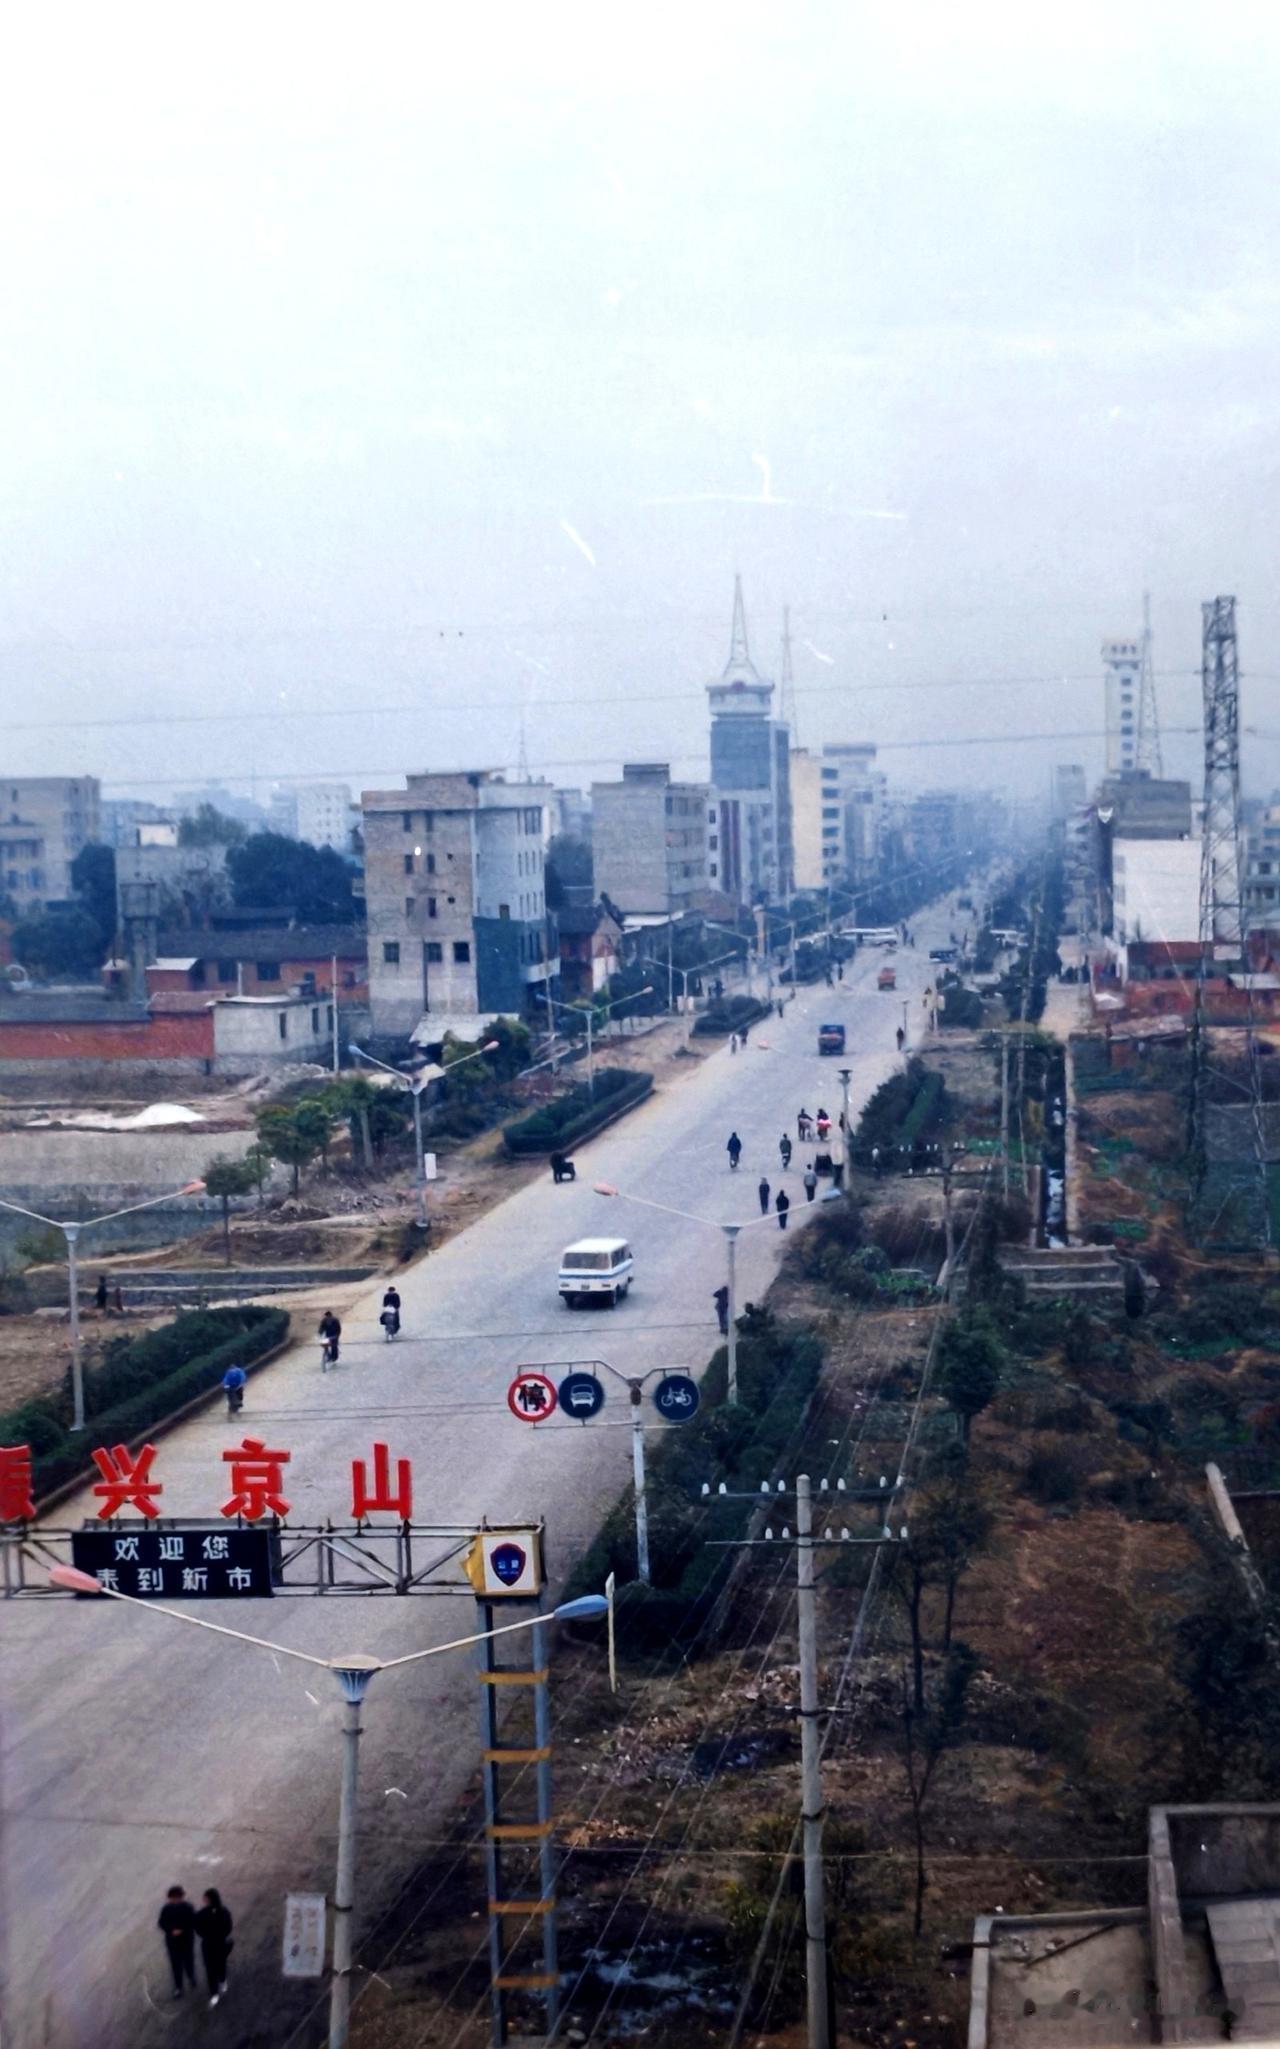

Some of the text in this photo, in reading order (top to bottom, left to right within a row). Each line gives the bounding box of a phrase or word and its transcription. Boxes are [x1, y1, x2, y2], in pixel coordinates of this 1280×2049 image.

[114, 1536, 229, 1560] 欢迎您
[96, 1567, 252, 1592] 来到新市
